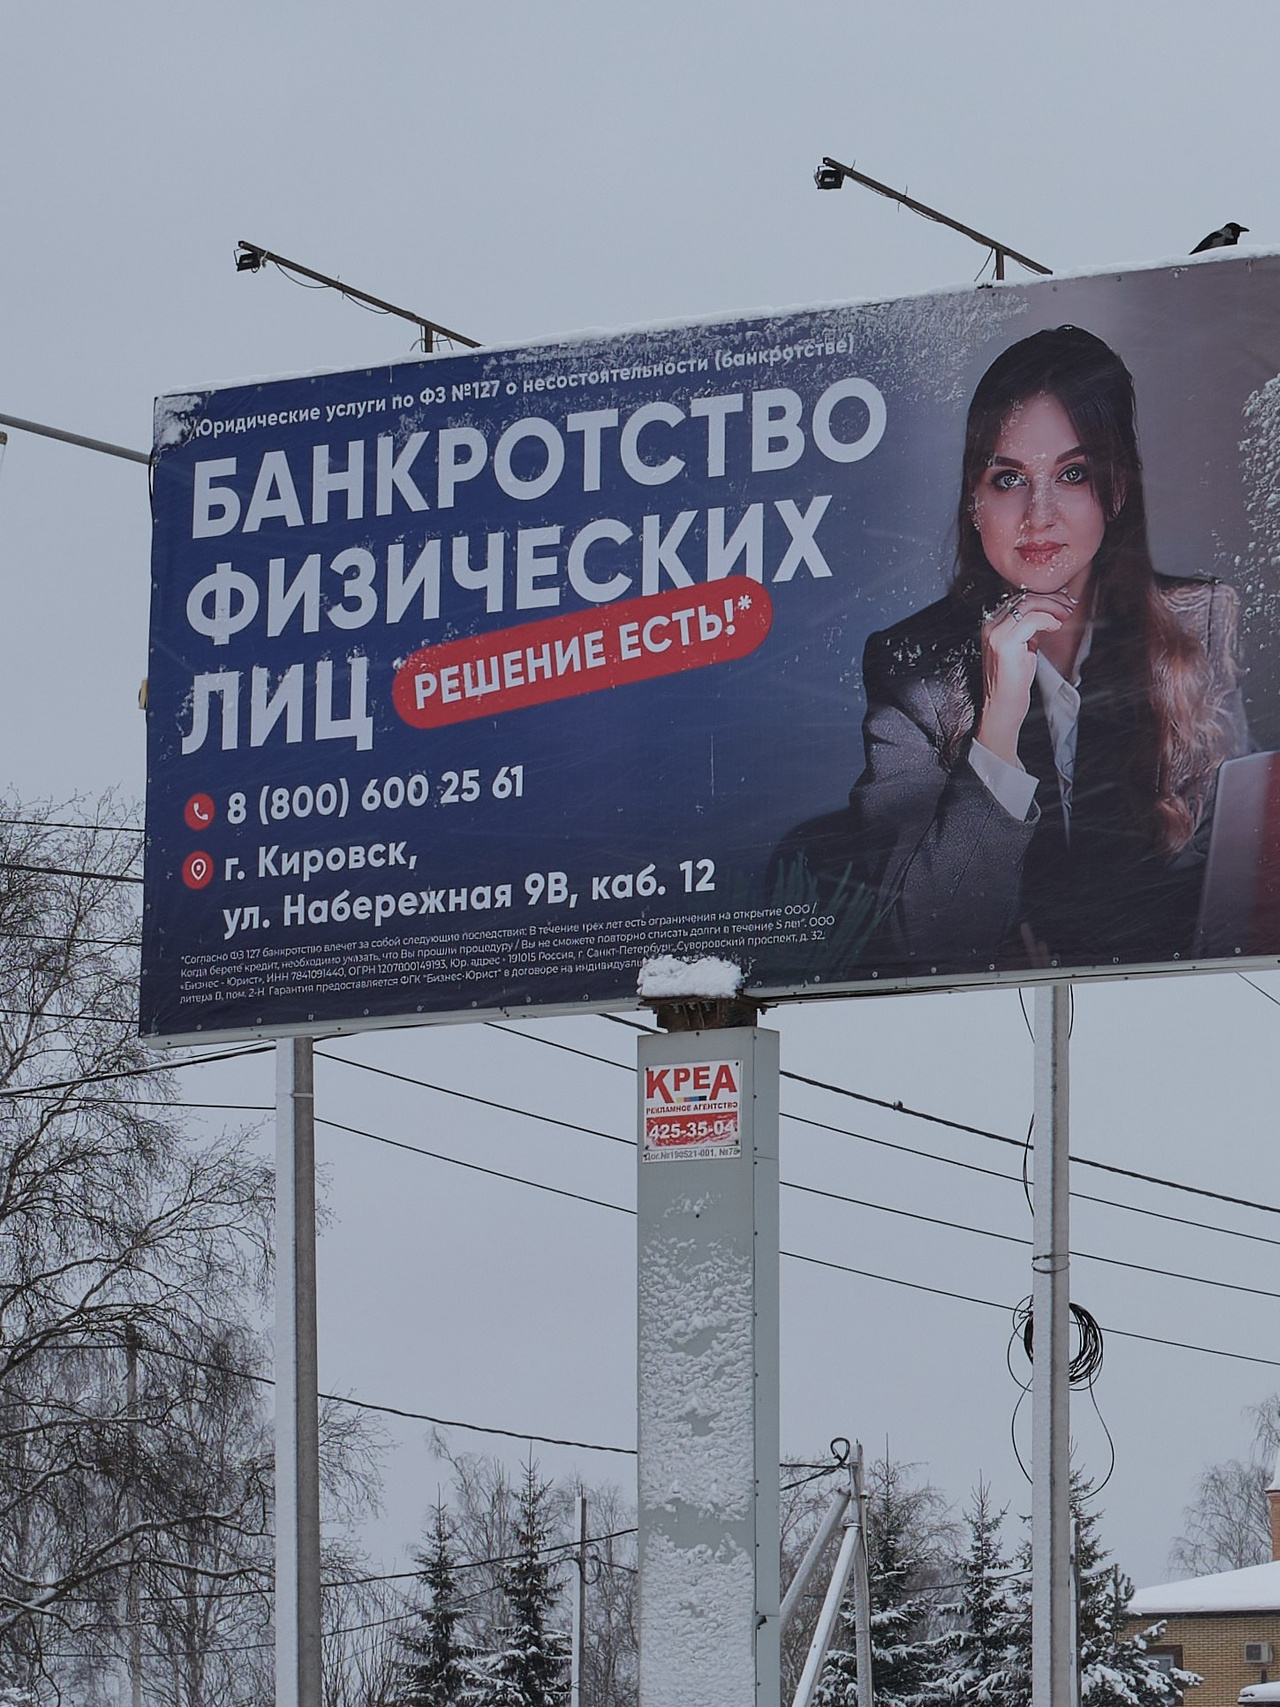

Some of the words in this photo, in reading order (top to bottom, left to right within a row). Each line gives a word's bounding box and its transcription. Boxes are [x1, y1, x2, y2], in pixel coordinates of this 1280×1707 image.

[196, 407, 320, 438] Юридические
[325, 398, 386, 423] услуги
[391, 394, 414, 409] по
[419, 385, 446, 406] ФЗ
[451, 380, 500, 401] №127
[506, 381, 516, 395] о
[522, 358, 708, 393] несостоятельности
[714, 340, 855, 373] (банкротстве)
[191, 377, 888, 539] БАНКРОТСТВО
[186, 494, 833, 646] ФИЗИЧЕСКИХ
[414, 630, 606, 710] РЕШЕНИЕ
[181, 656, 374, 756] ЛИЦ
[226, 792, 247, 825] 8
[258, 777, 350, 826] (800)
[361, 774, 430, 812] 600
[440, 768, 480, 804] 25
[492, 765, 524, 799] 61
[224, 857, 246, 881] г.
[258, 841, 418, 882] Кировск,
[222, 905, 271, 940] ул.
[282, 882, 513, 927] Набережная
[524, 871, 579, 909] 9В,
[590, 865, 666, 900] каб.
[678, 858, 716, 894] 12
[180, 970, 207, 979] Когда
[417, 948, 457, 960] прошли
[458, 944, 514, 956] процедуру
[552, 937, 594, 948] сможете
[597, 932, 645, 944] повторно
[808, 914, 834, 927] ООО
[245, 950, 260, 960] 127
[370, 937, 400, 950] собой
[538, 925, 579, 936] течение
[605, 921, 622, 931] лет
[647, 914, 716, 927] ограничения
[732, 908, 782, 920] открытие
[783, 904, 810, 916] ООО
[266, 974, 288, 985] ИНН
[347, 967, 375, 978] ОГРН
[268, 986, 313, 997] Гарантия
[646, 1064, 738, 1104] КРЕА
[646, 1104, 691, 1114] РЕКЛАМНОЕ
[693, 1102, 738, 1112] АГЕНТСТВО
[649, 1119, 734, 1140] 425-35-04
